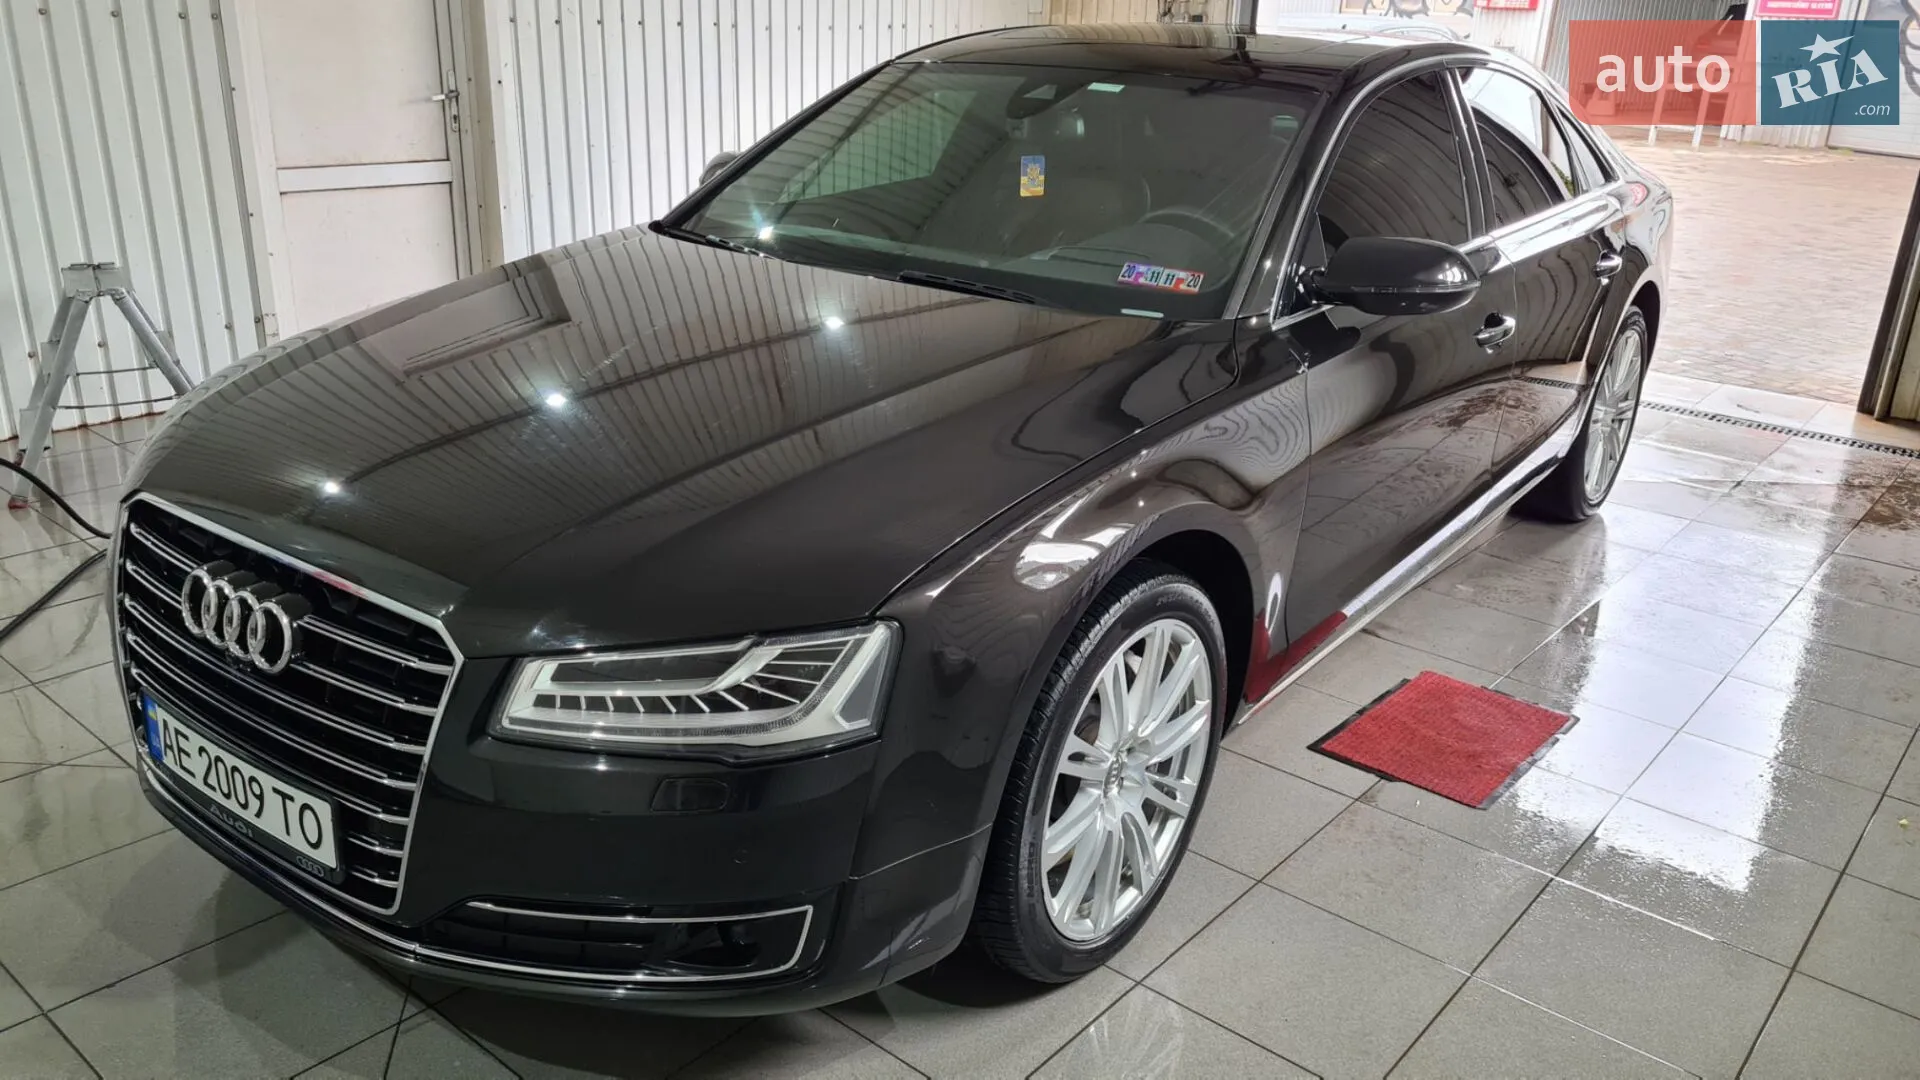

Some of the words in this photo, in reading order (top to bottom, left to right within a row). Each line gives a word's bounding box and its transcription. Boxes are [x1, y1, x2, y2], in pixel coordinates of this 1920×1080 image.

[1121, 264, 1136, 279] 20
[1149, 270, 1160, 283] 11
[1163, 273, 1175, 286] 11
[1187, 273, 1201, 288] 20
[163, 718, 196, 779] AE
[198, 745, 265, 819] 2009
[271, 786, 323, 850] TO
